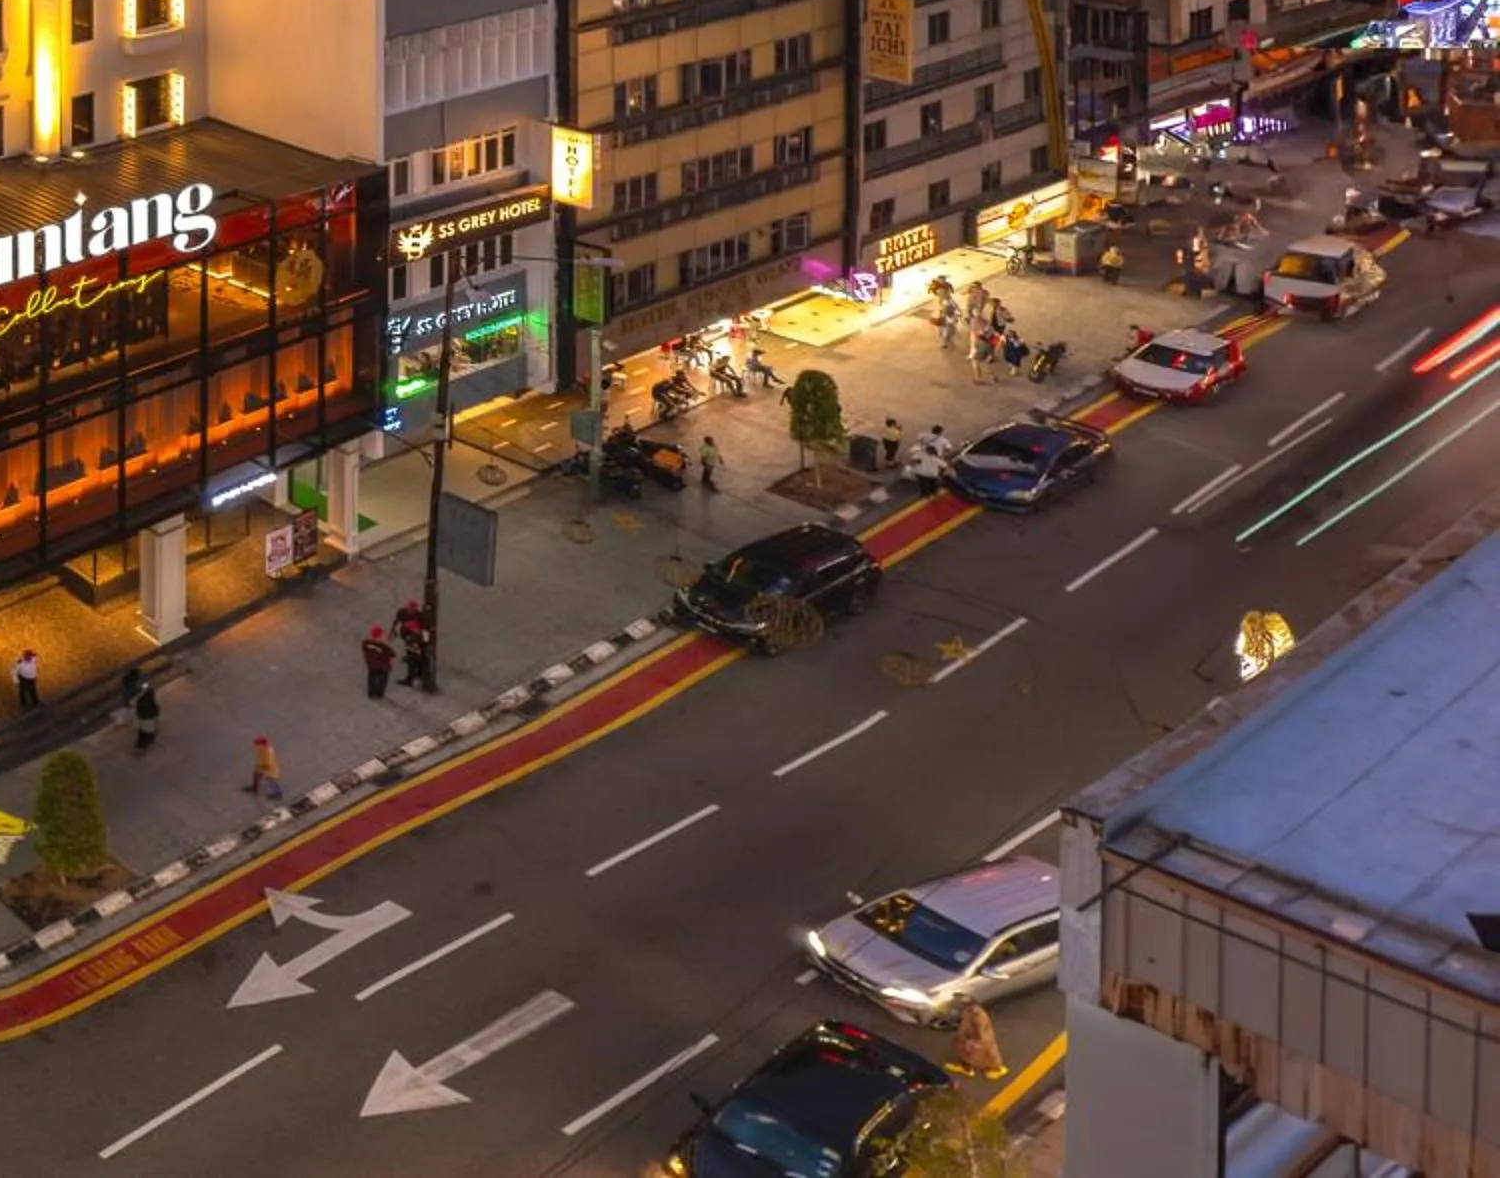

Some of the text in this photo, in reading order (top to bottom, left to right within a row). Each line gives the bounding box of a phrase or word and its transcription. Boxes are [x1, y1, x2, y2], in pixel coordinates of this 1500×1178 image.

[873, 19, 900, 38] TAI
[871, 35, 906, 55] ICHI
[438, 198, 541, 239] SS GREY HOTEL
[880, 224, 934, 255] HOTEL
